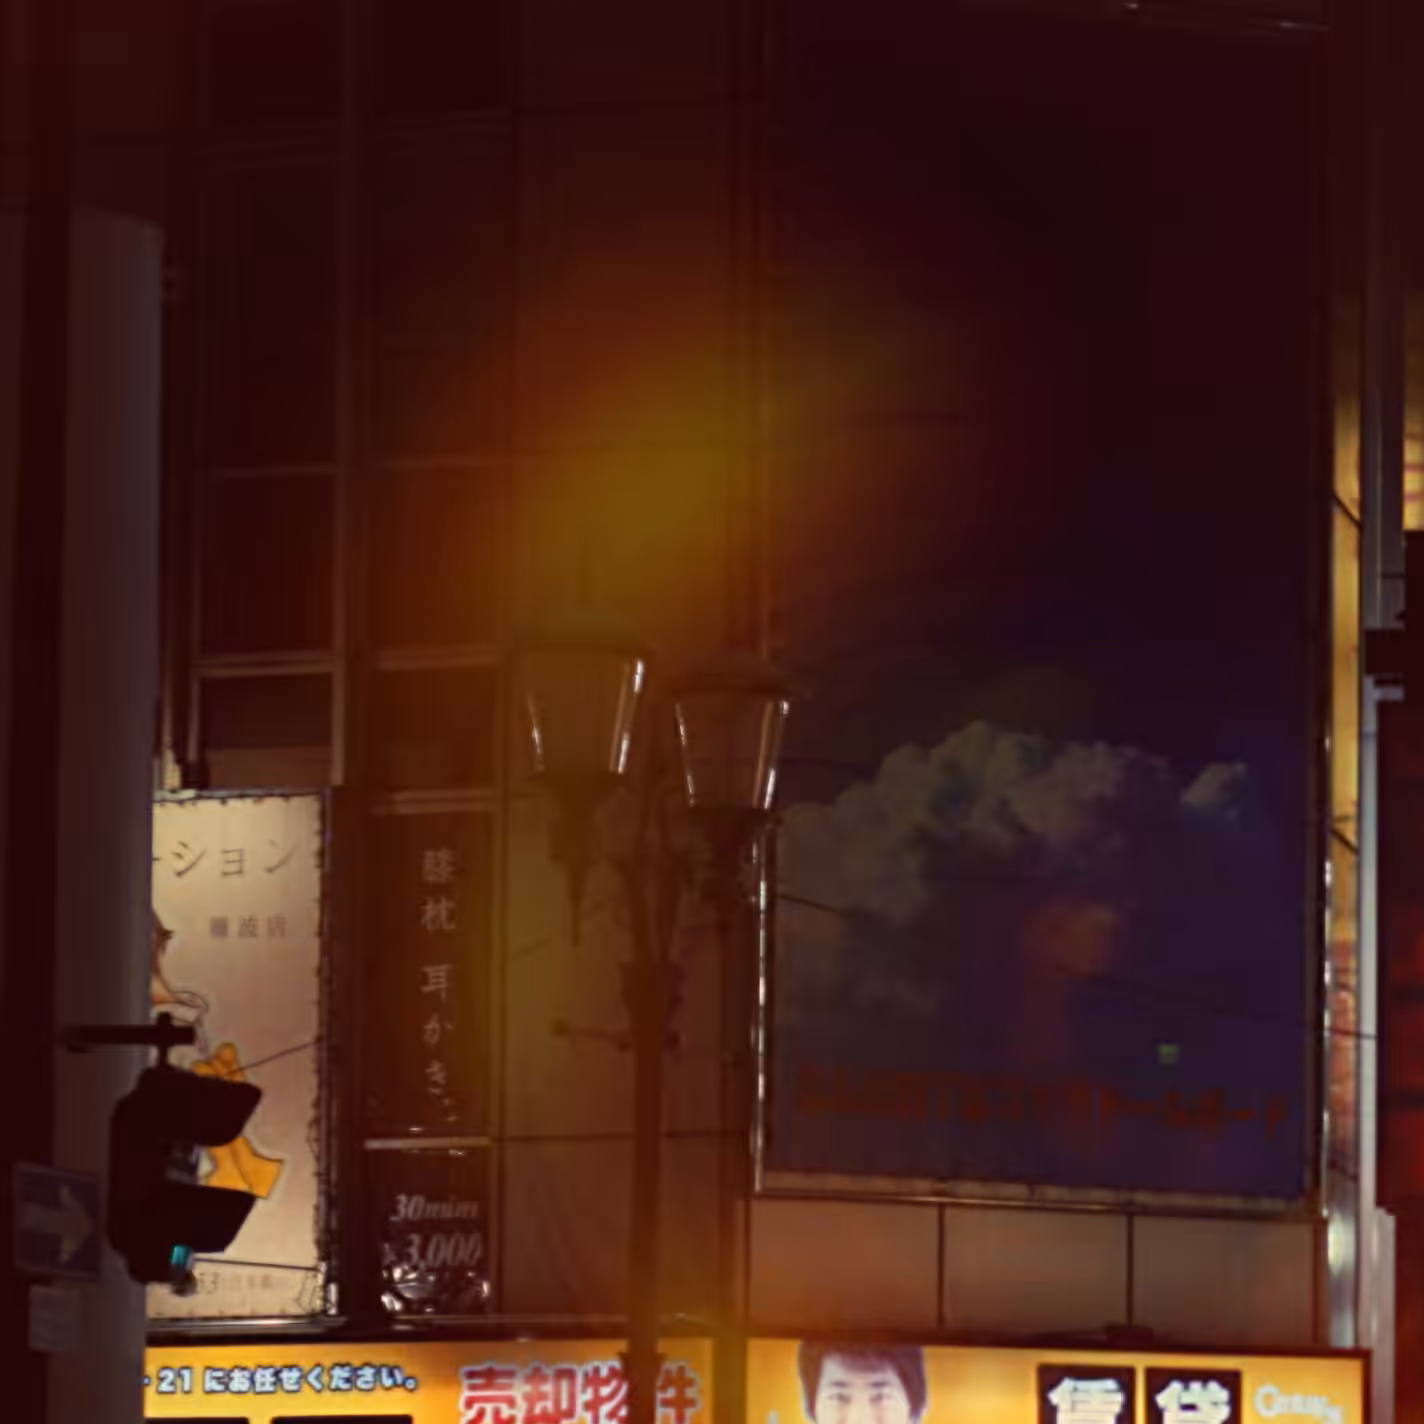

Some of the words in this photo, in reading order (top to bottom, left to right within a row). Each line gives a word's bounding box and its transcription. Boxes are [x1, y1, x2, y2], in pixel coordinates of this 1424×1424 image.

[203, 1363, 418, 1393] にお任せください。
